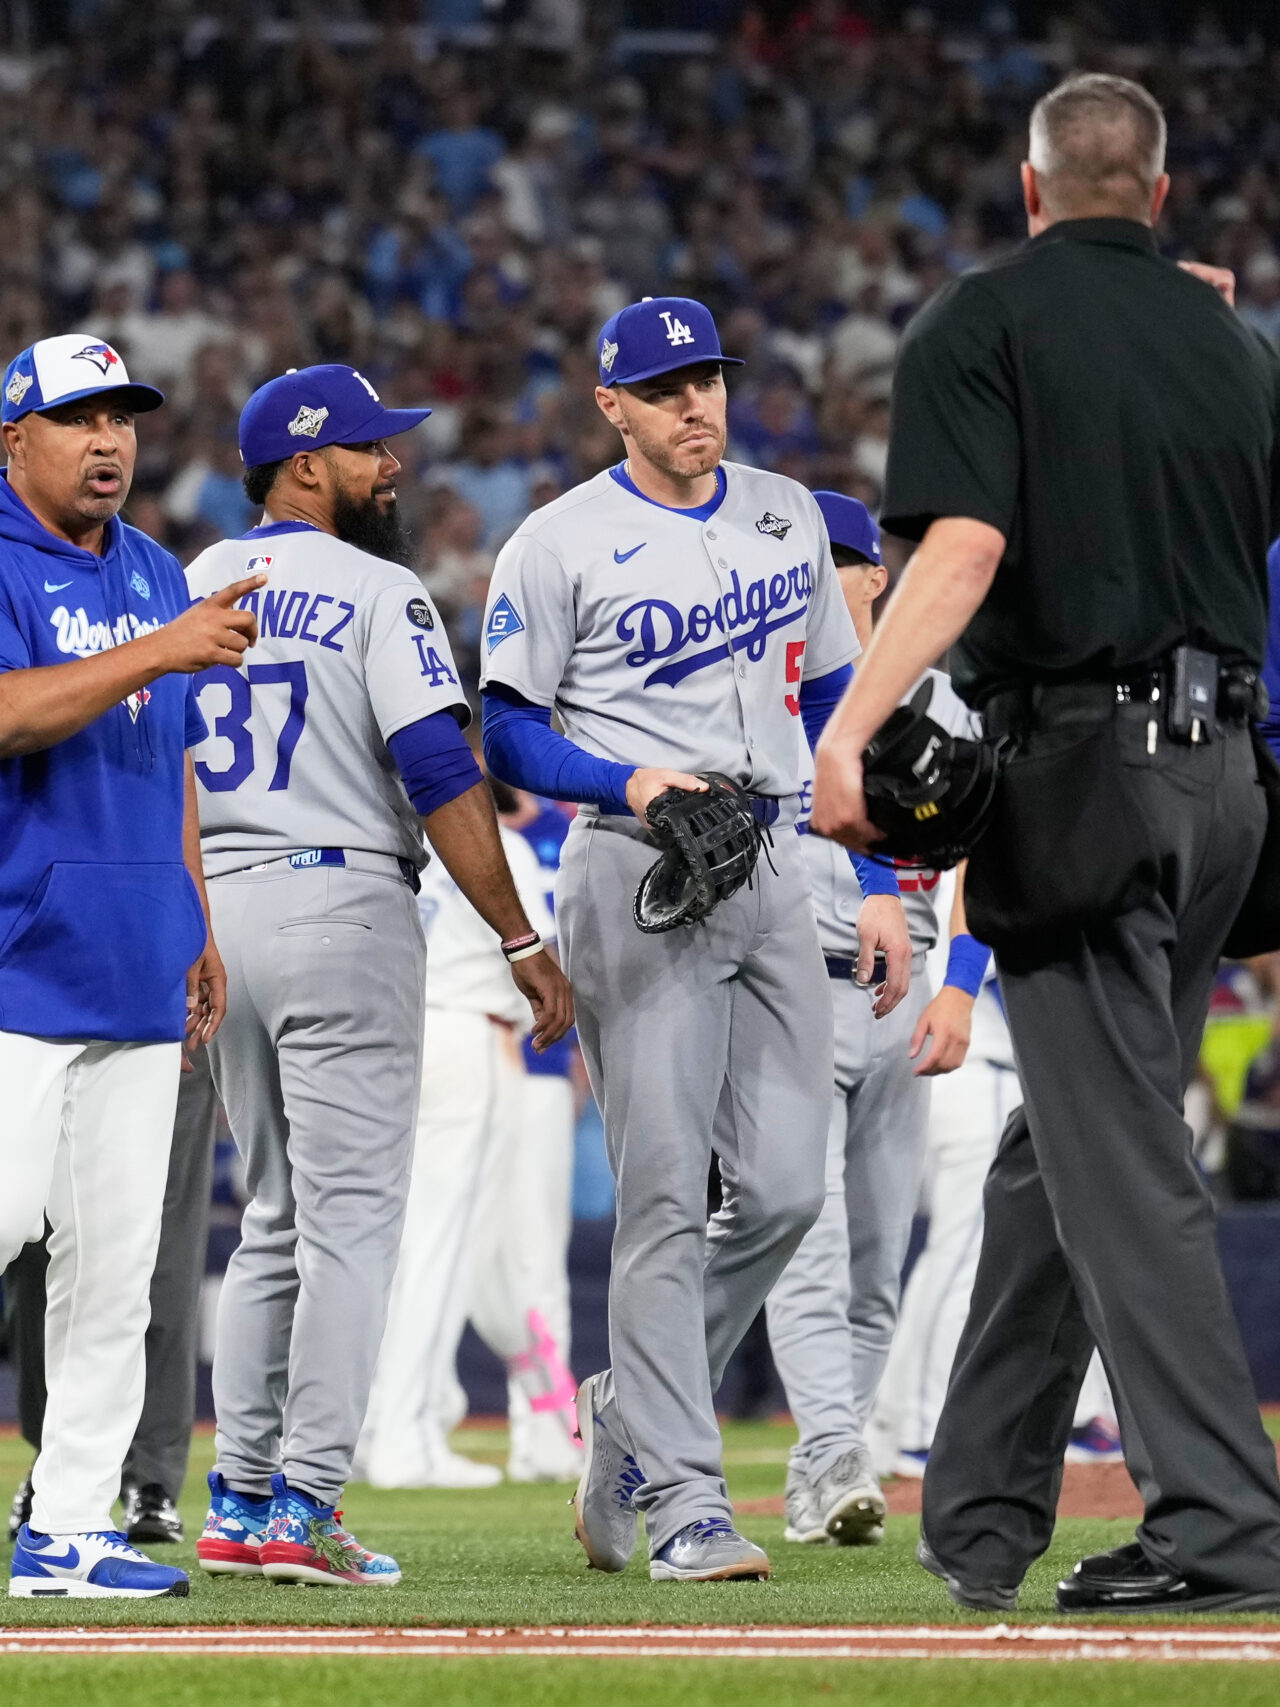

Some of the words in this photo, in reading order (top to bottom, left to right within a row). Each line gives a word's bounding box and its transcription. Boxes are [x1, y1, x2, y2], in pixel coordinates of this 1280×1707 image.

[658, 312, 695, 347] LA
[190, 590, 355, 653] NDEZ
[491, 611, 509, 630] G
[616, 561, 812, 668] Dodgers
[411, 634, 458, 687] LA
[192, 660, 309, 793] 37
[270, 1518, 290, 1535] 37
